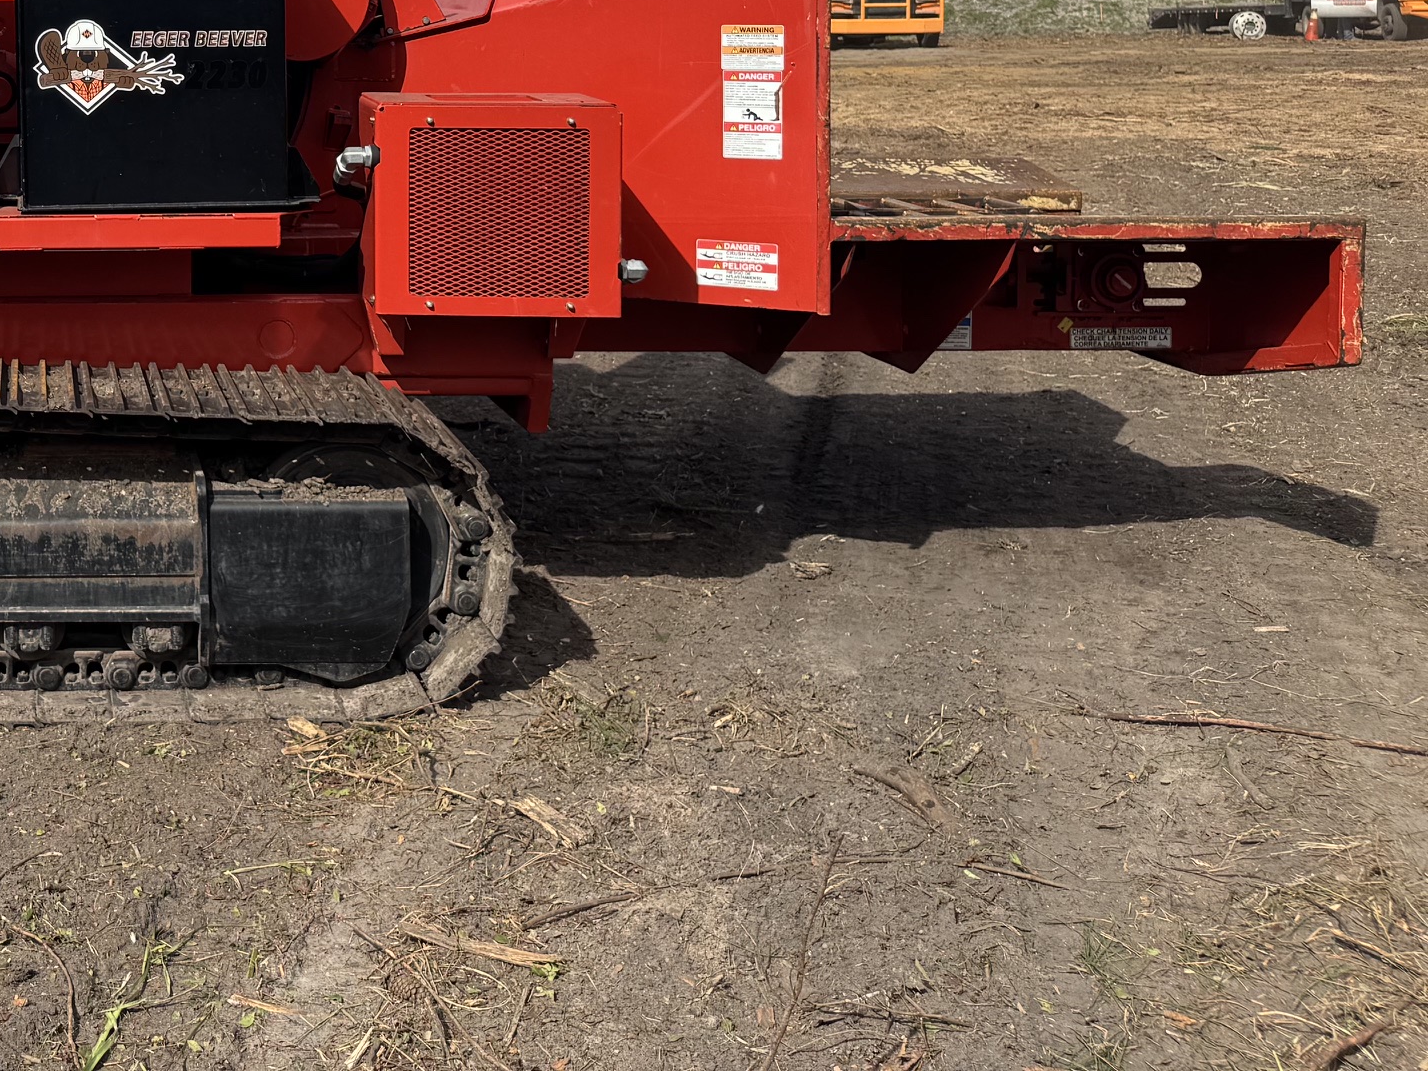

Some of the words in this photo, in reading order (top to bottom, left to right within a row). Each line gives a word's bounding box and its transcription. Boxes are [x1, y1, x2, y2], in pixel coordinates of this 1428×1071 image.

[130, 31, 191, 48] EEGER
[194, 30, 268, 47] BEEVER
[185, 60, 268, 90] 2230
[738, 124, 776, 132] PELIGRO
[724, 243, 761, 251] DANGER
[722, 262, 763, 272] PELIGRO
